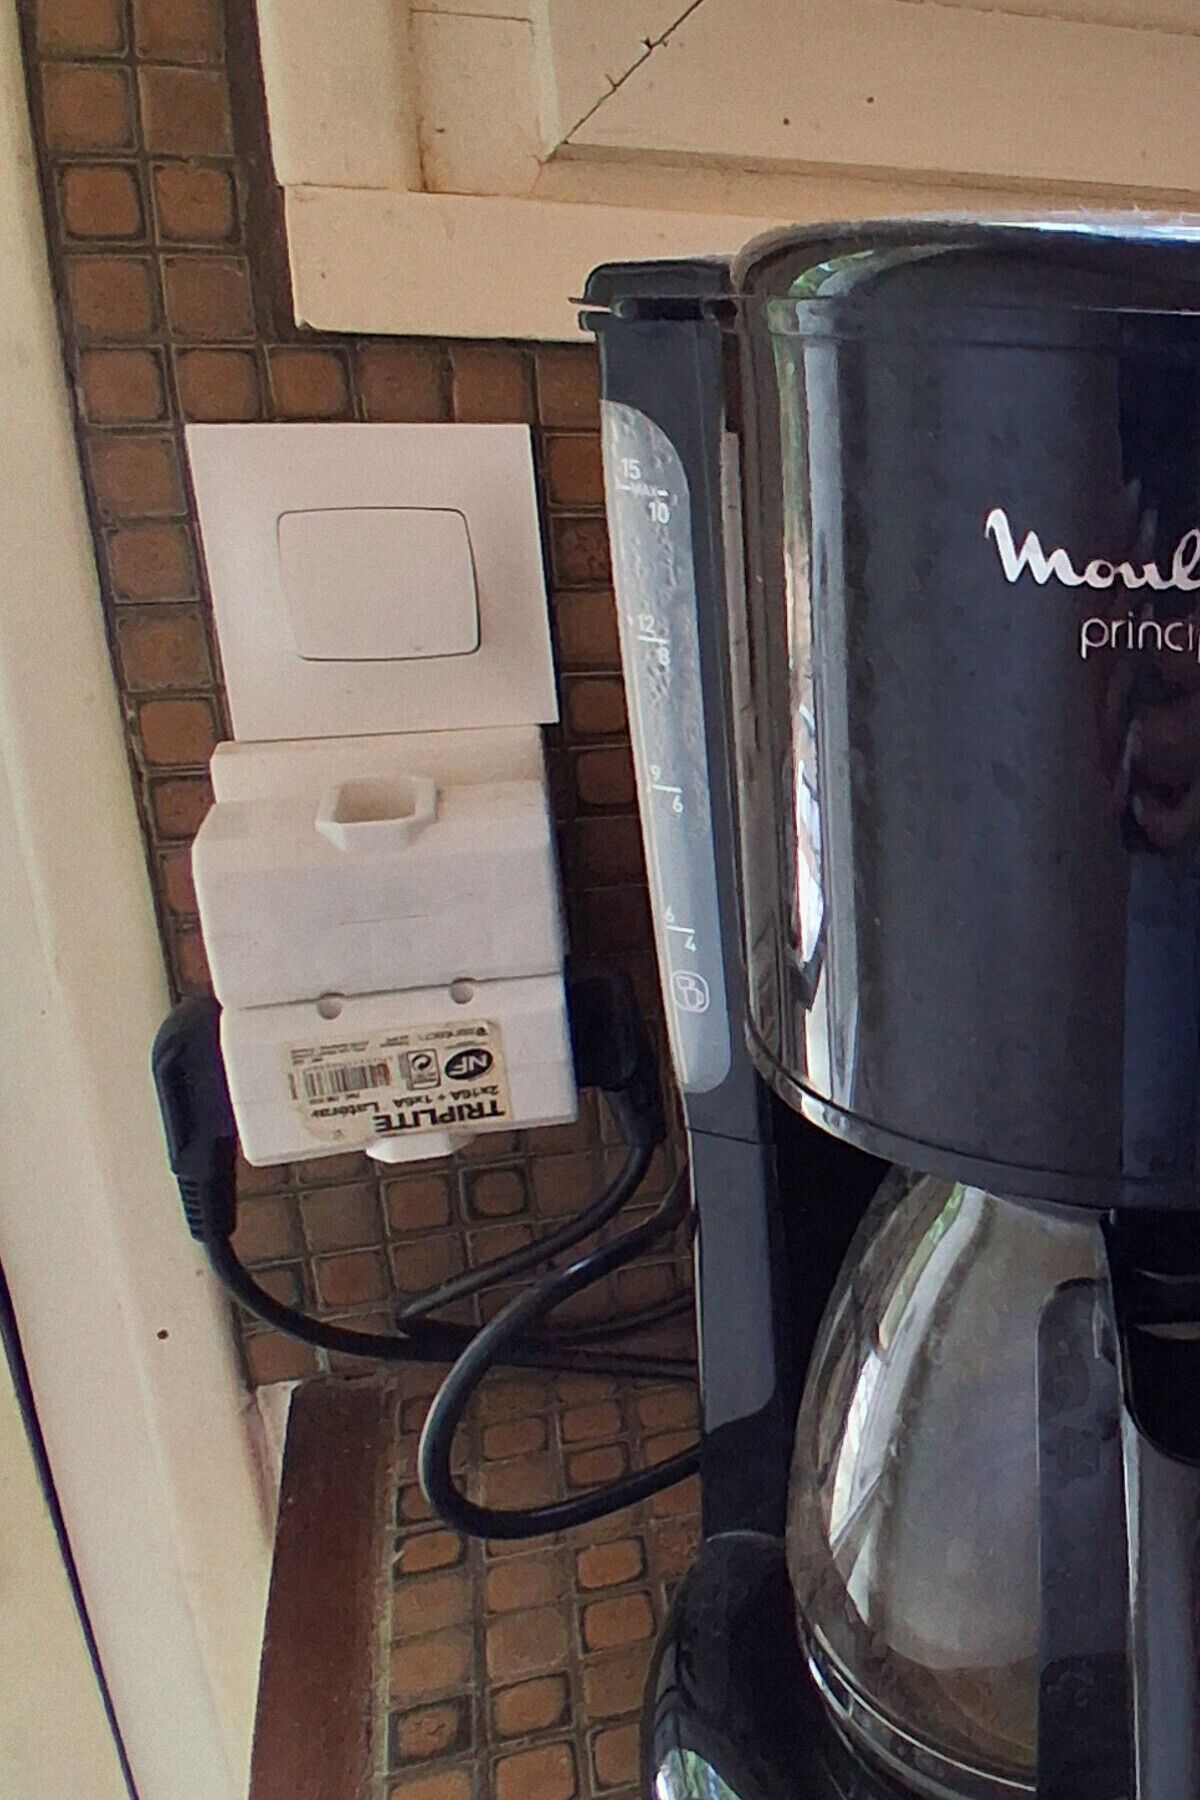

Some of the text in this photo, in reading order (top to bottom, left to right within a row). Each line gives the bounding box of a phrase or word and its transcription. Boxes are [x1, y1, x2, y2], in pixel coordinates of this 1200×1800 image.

[621, 457, 641, 480] 15
[648, 501, 670, 524] 10
[638, 614, 656, 634] 12
[658, 646, 671, 666] 8
[651, 765, 661, 782] 9
[672, 794, 684, 813] 6
[665, 905, 676, 923] 6
[684, 935, 697, 952] 4
[448, 1054, 489, 1075] NF
[371, 1098, 506, 1133] TRIPLITE
